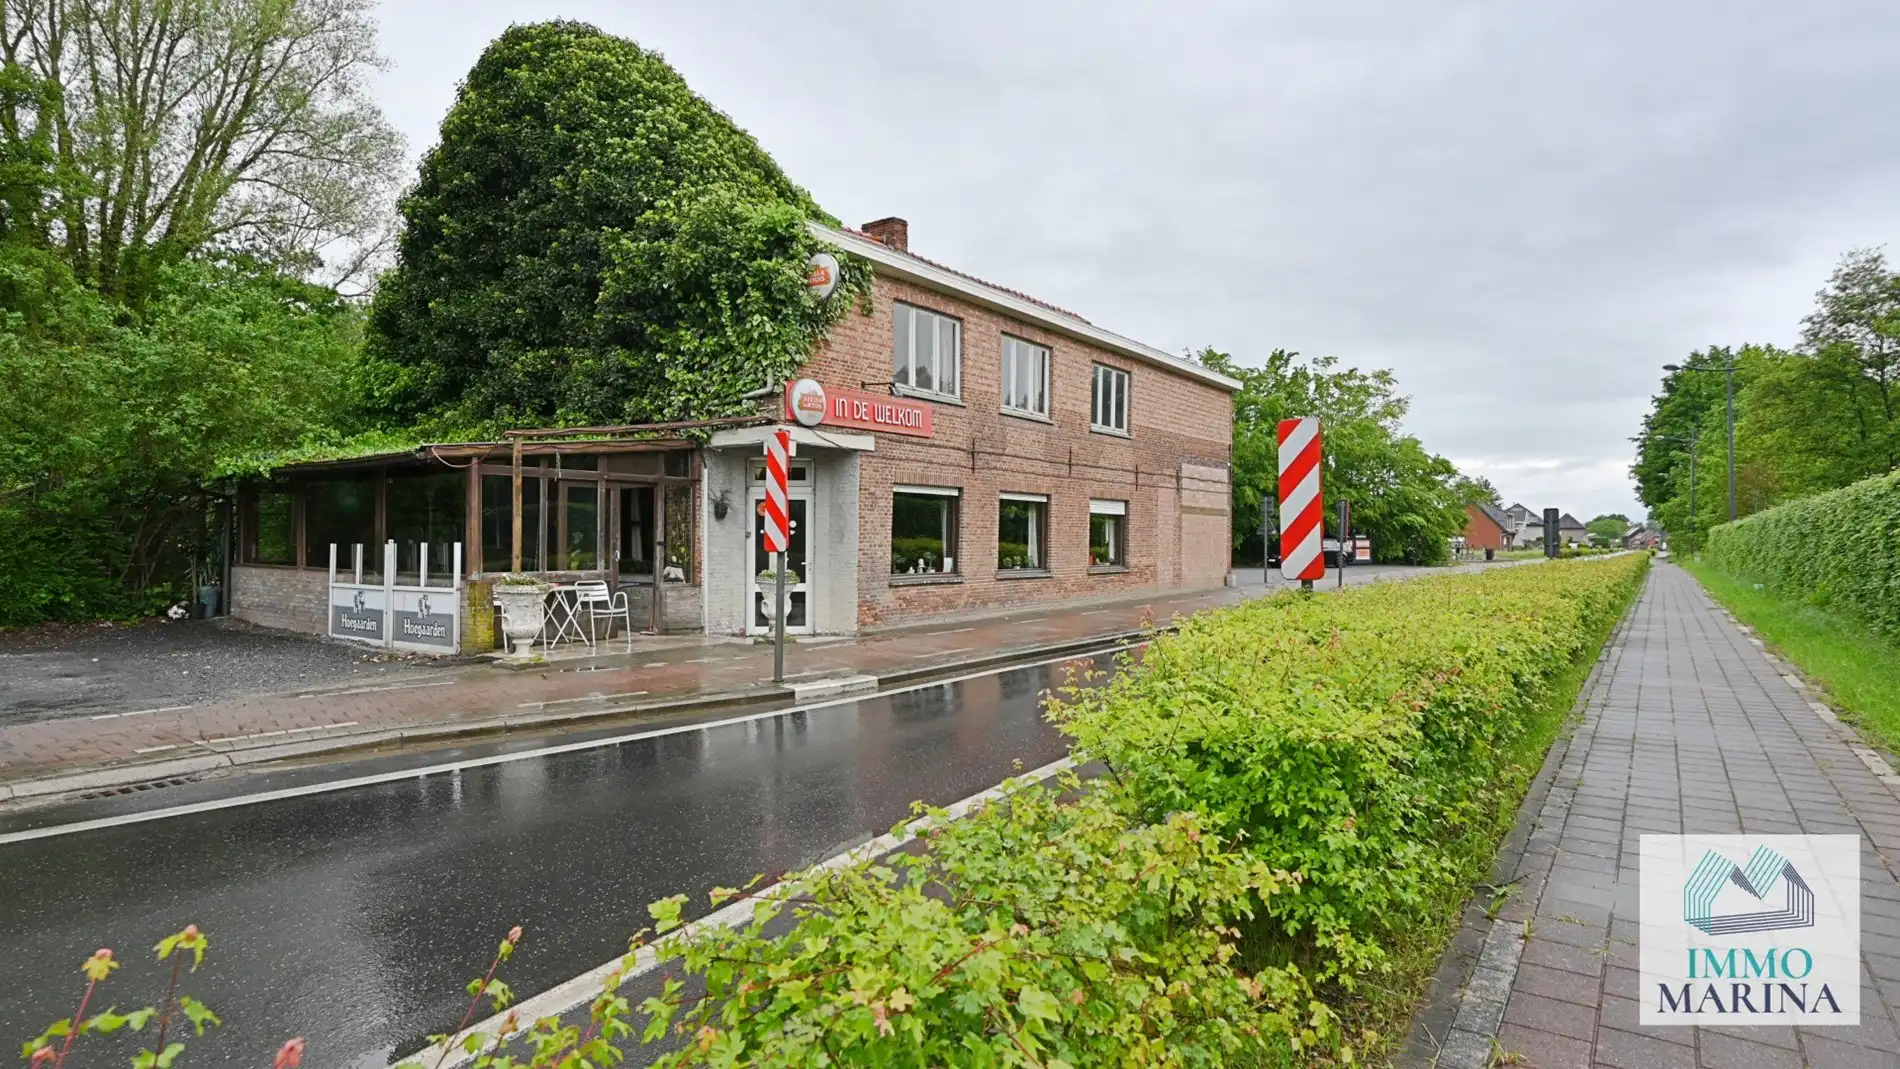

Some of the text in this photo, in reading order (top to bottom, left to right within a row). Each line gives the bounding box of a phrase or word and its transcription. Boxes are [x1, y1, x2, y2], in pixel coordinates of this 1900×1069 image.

[836, 397, 922, 428] IN DE WELKOM
[341, 613, 377, 632] Hoegaarden
[404, 618, 446, 638] Hoegaarden
